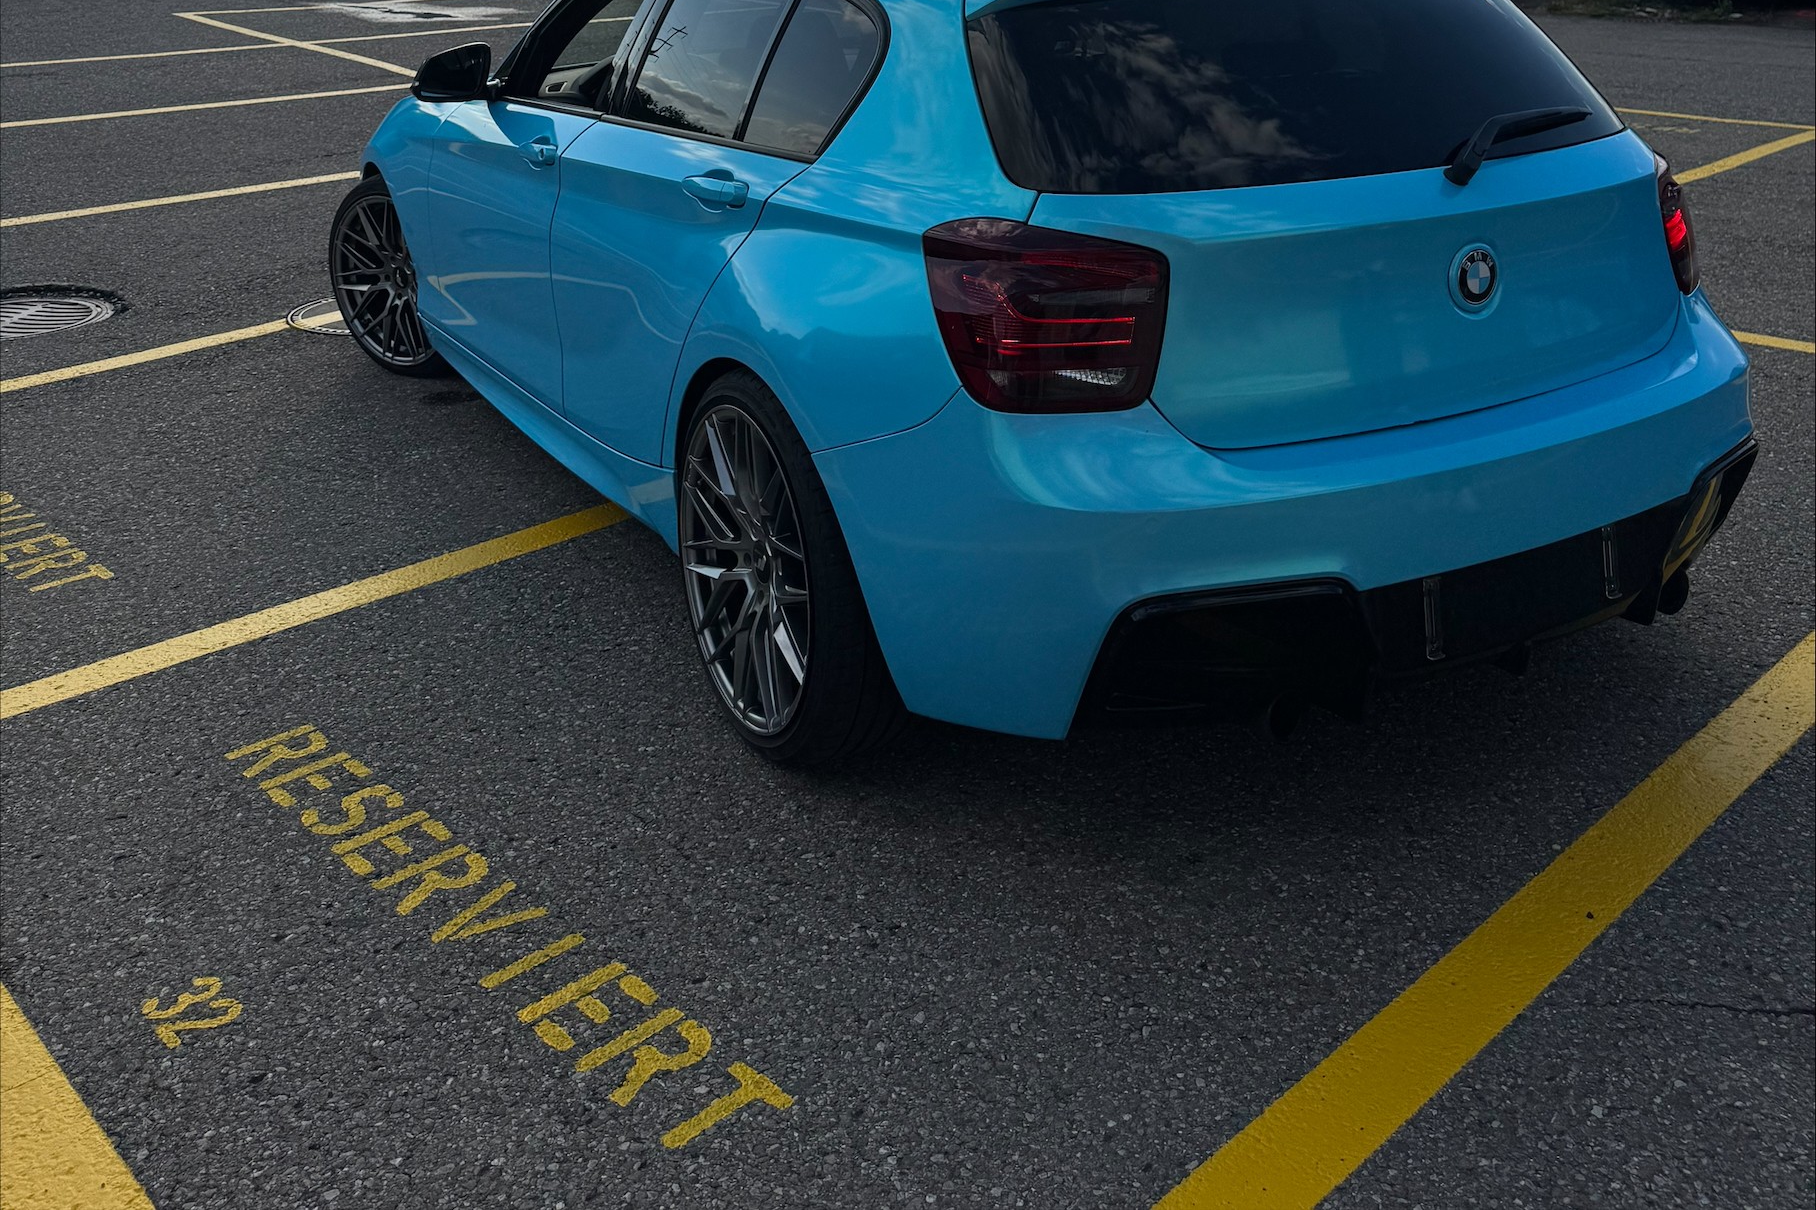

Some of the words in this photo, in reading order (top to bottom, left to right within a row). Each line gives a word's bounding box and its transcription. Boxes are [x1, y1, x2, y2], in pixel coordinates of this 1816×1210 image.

[1462, 252, 1494, 271] BMW
[225, 724, 794, 1149] RESERVIERT
[142, 977, 242, 1049] 32
